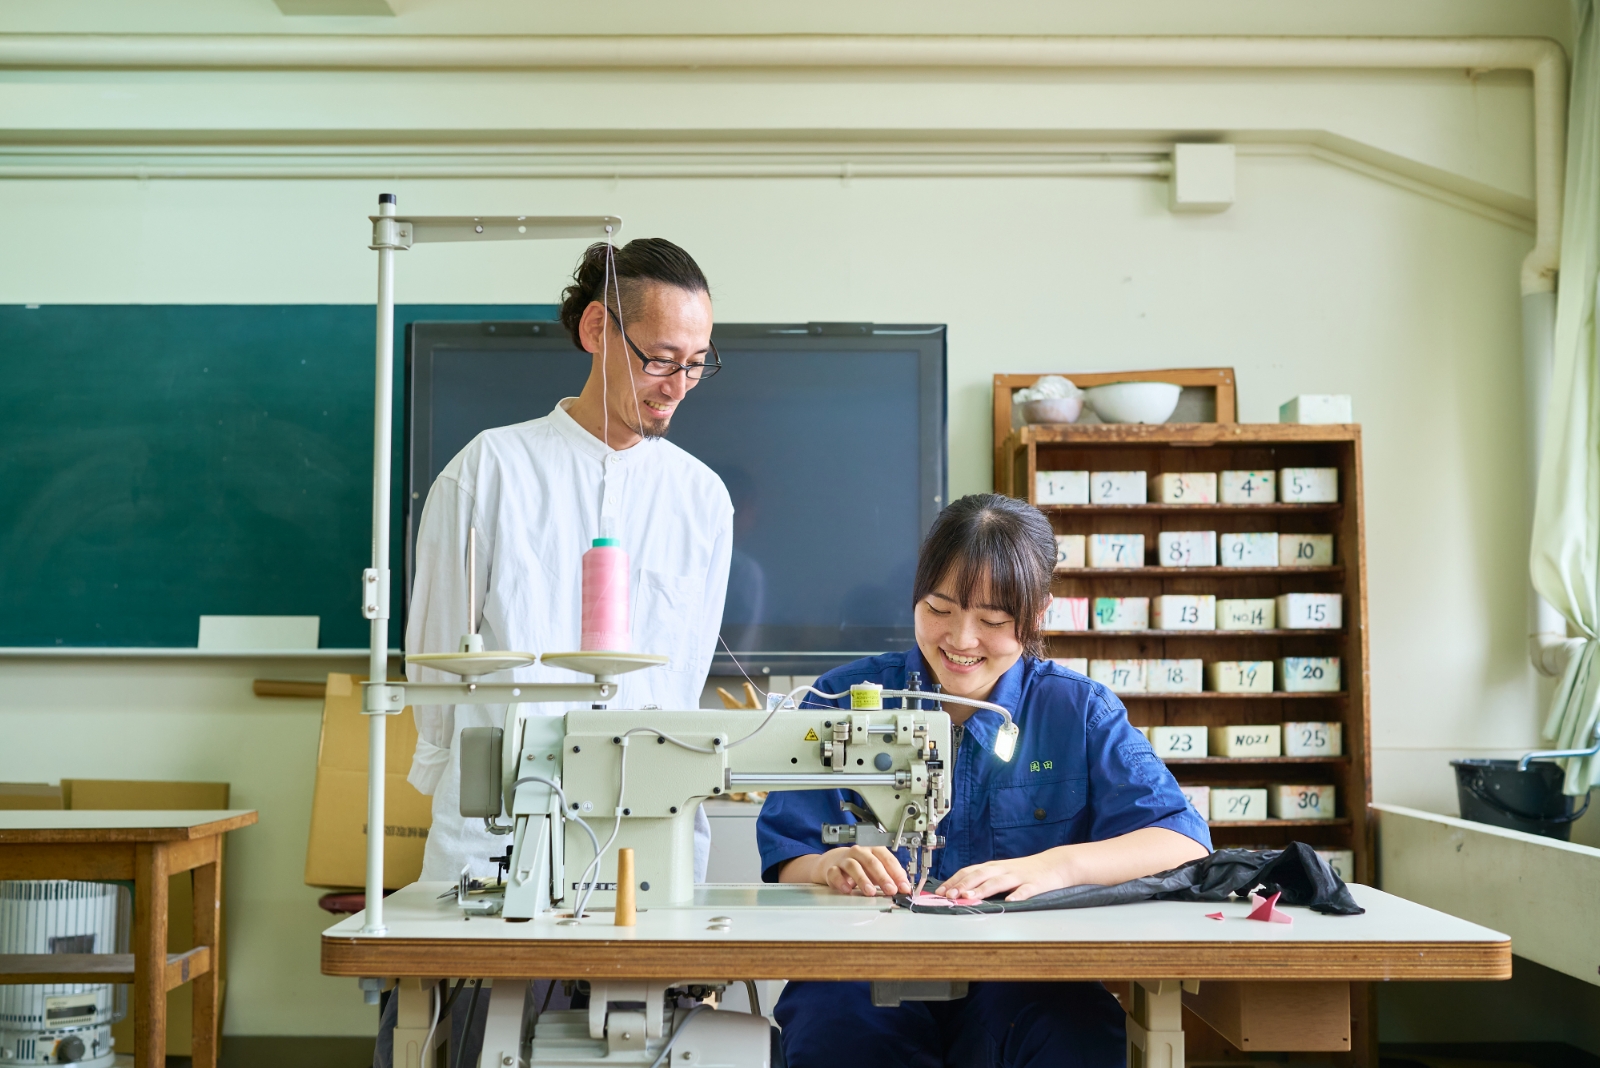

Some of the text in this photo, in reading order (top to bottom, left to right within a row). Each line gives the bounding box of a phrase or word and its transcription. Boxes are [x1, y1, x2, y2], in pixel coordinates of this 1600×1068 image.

[1173, 478, 1185, 499] 3
[1241, 479, 1255, 498] 4
[1111, 543, 1125, 562] 7
[1297, 541, 1315, 560] 10
[1180, 605, 1199, 624] 13
[1306, 603, 1326, 622] 15
[1111, 669, 1131, 687] 17
[1167, 668, 1184, 684] 18
[1238, 668, 1258, 687] 19
[1302, 665, 1324, 680] 20
[1169, 733, 1193, 752] 23
[1302, 729, 1326, 748] 25
[1228, 794, 1252, 816] 29
[1297, 791, 1320, 809] 30
